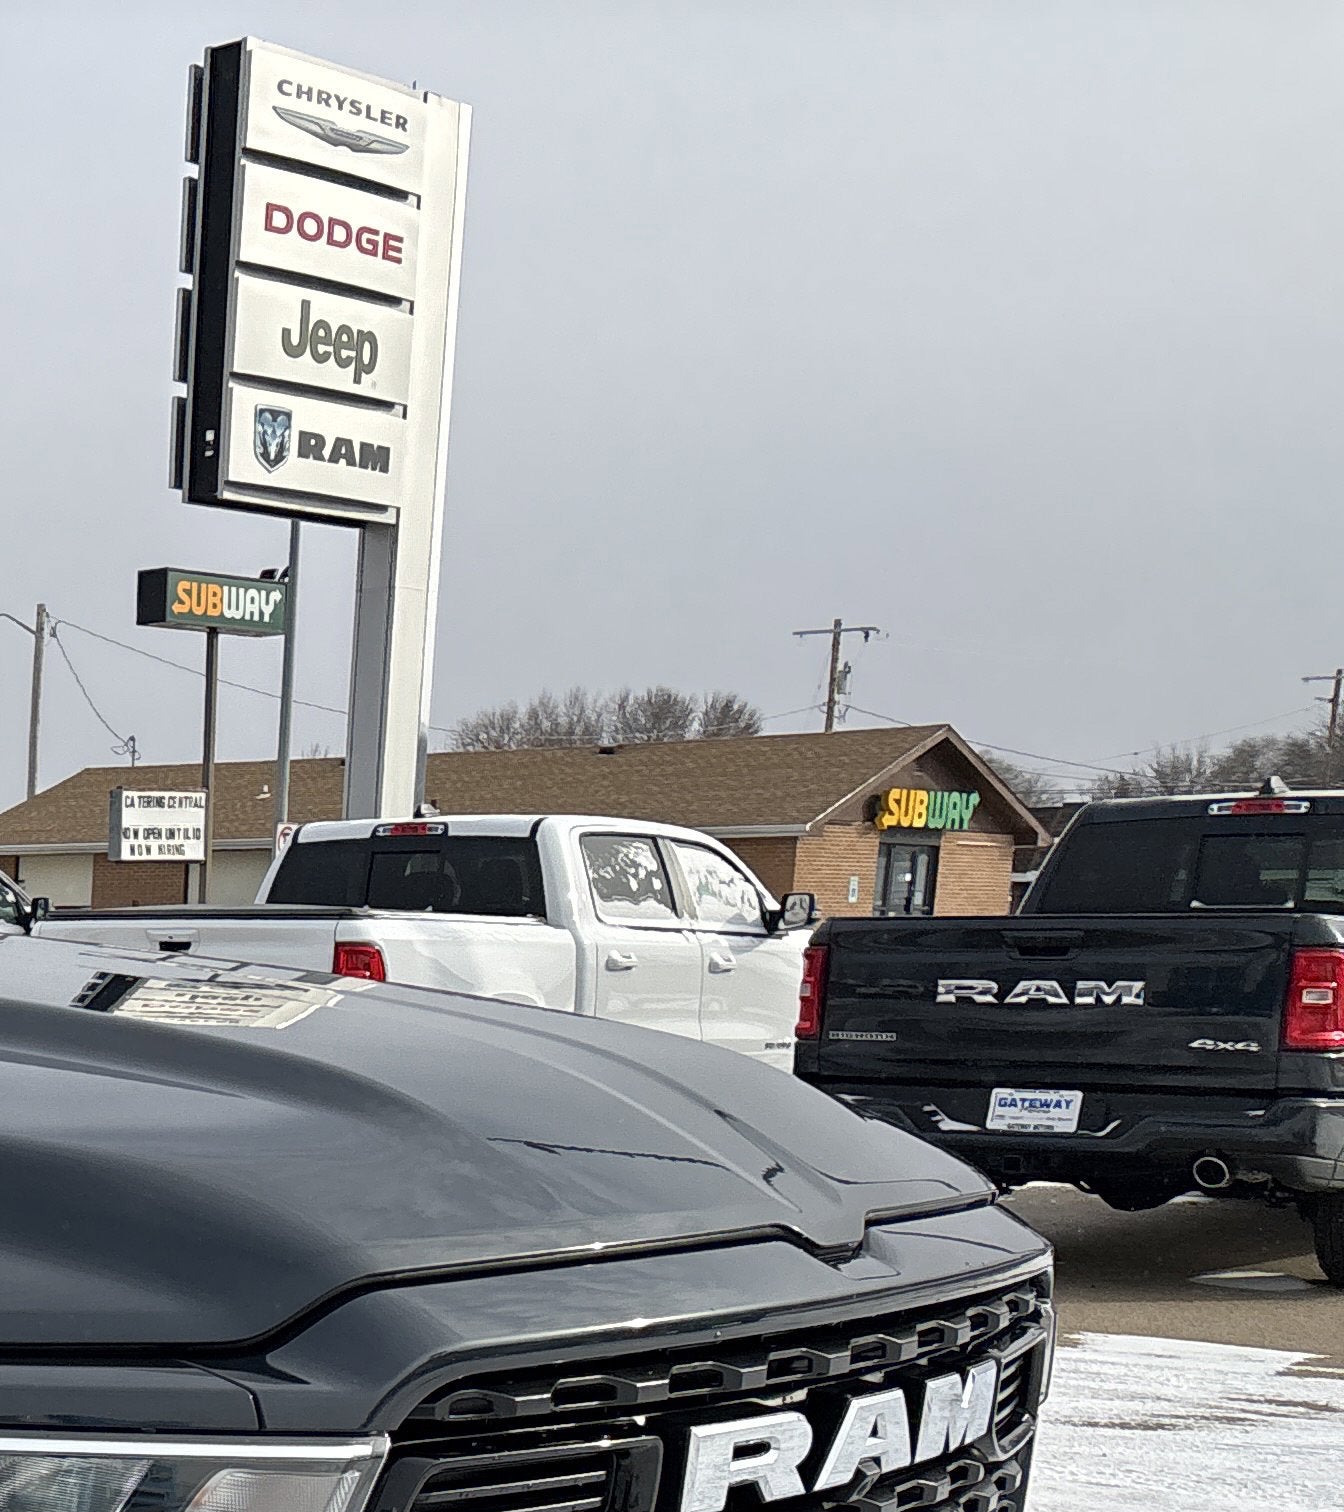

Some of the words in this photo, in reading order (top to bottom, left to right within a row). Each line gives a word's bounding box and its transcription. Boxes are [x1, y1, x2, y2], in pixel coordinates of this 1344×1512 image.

[276, 78, 409, 133] CHRYSLER
[264, 202, 404, 265] DODGE
[281, 300, 378, 384] Jeep
[297, 430, 390, 474] RAM
[172, 580, 283, 622] SUBWAY
[875, 787, 981, 830] SUBWAY
[130, 843, 152, 856] NOW
[143, 827, 162, 840] OPEN
[936, 978, 1147, 1006] RAM
[1188, 1038, 1262, 1052] 4x4
[998, 1097, 1074, 1110] GATEWAY
